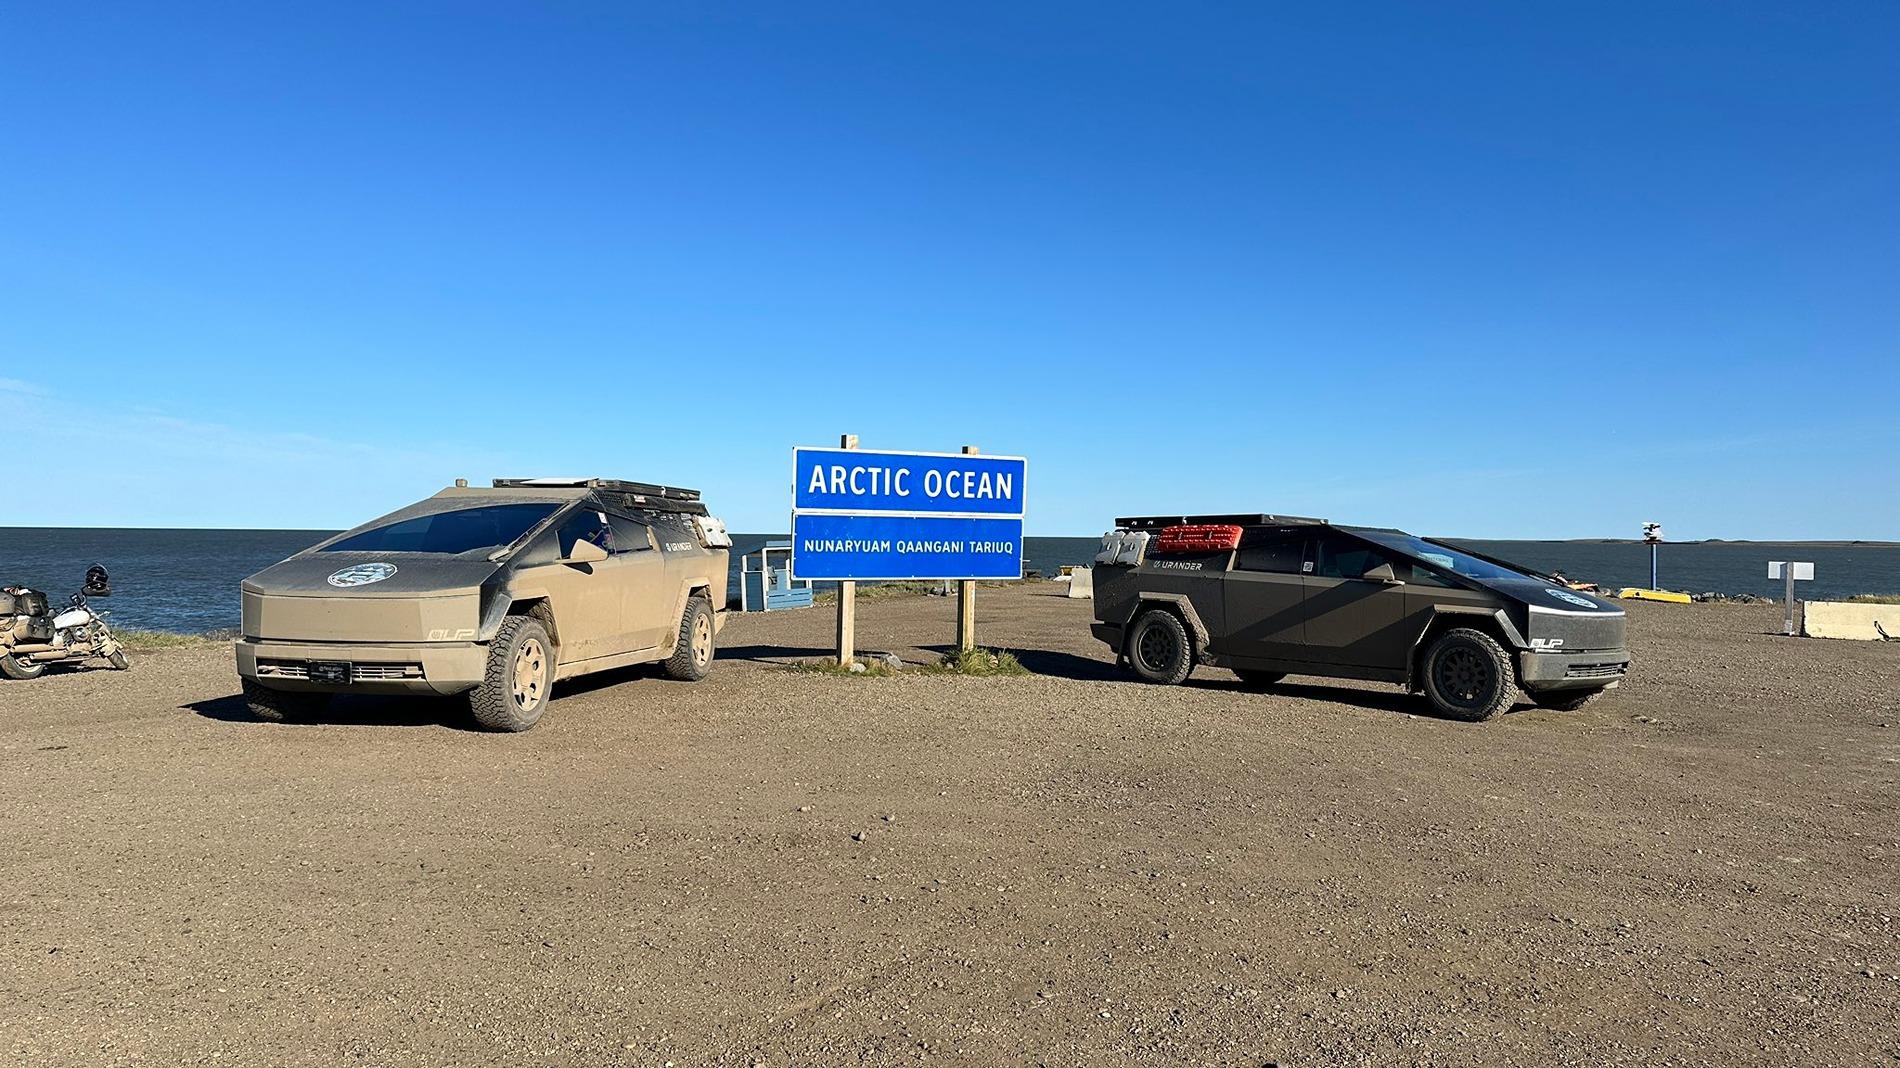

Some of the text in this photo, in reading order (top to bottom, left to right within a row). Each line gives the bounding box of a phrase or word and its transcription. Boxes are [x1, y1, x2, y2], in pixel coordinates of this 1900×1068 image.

[808, 464, 1012, 500] ARCTIC OCEAN
[804, 539, 1013, 555] NUNARYUAM QAANGANI TARIUQ
[1162, 561, 1203, 570] URANDER
